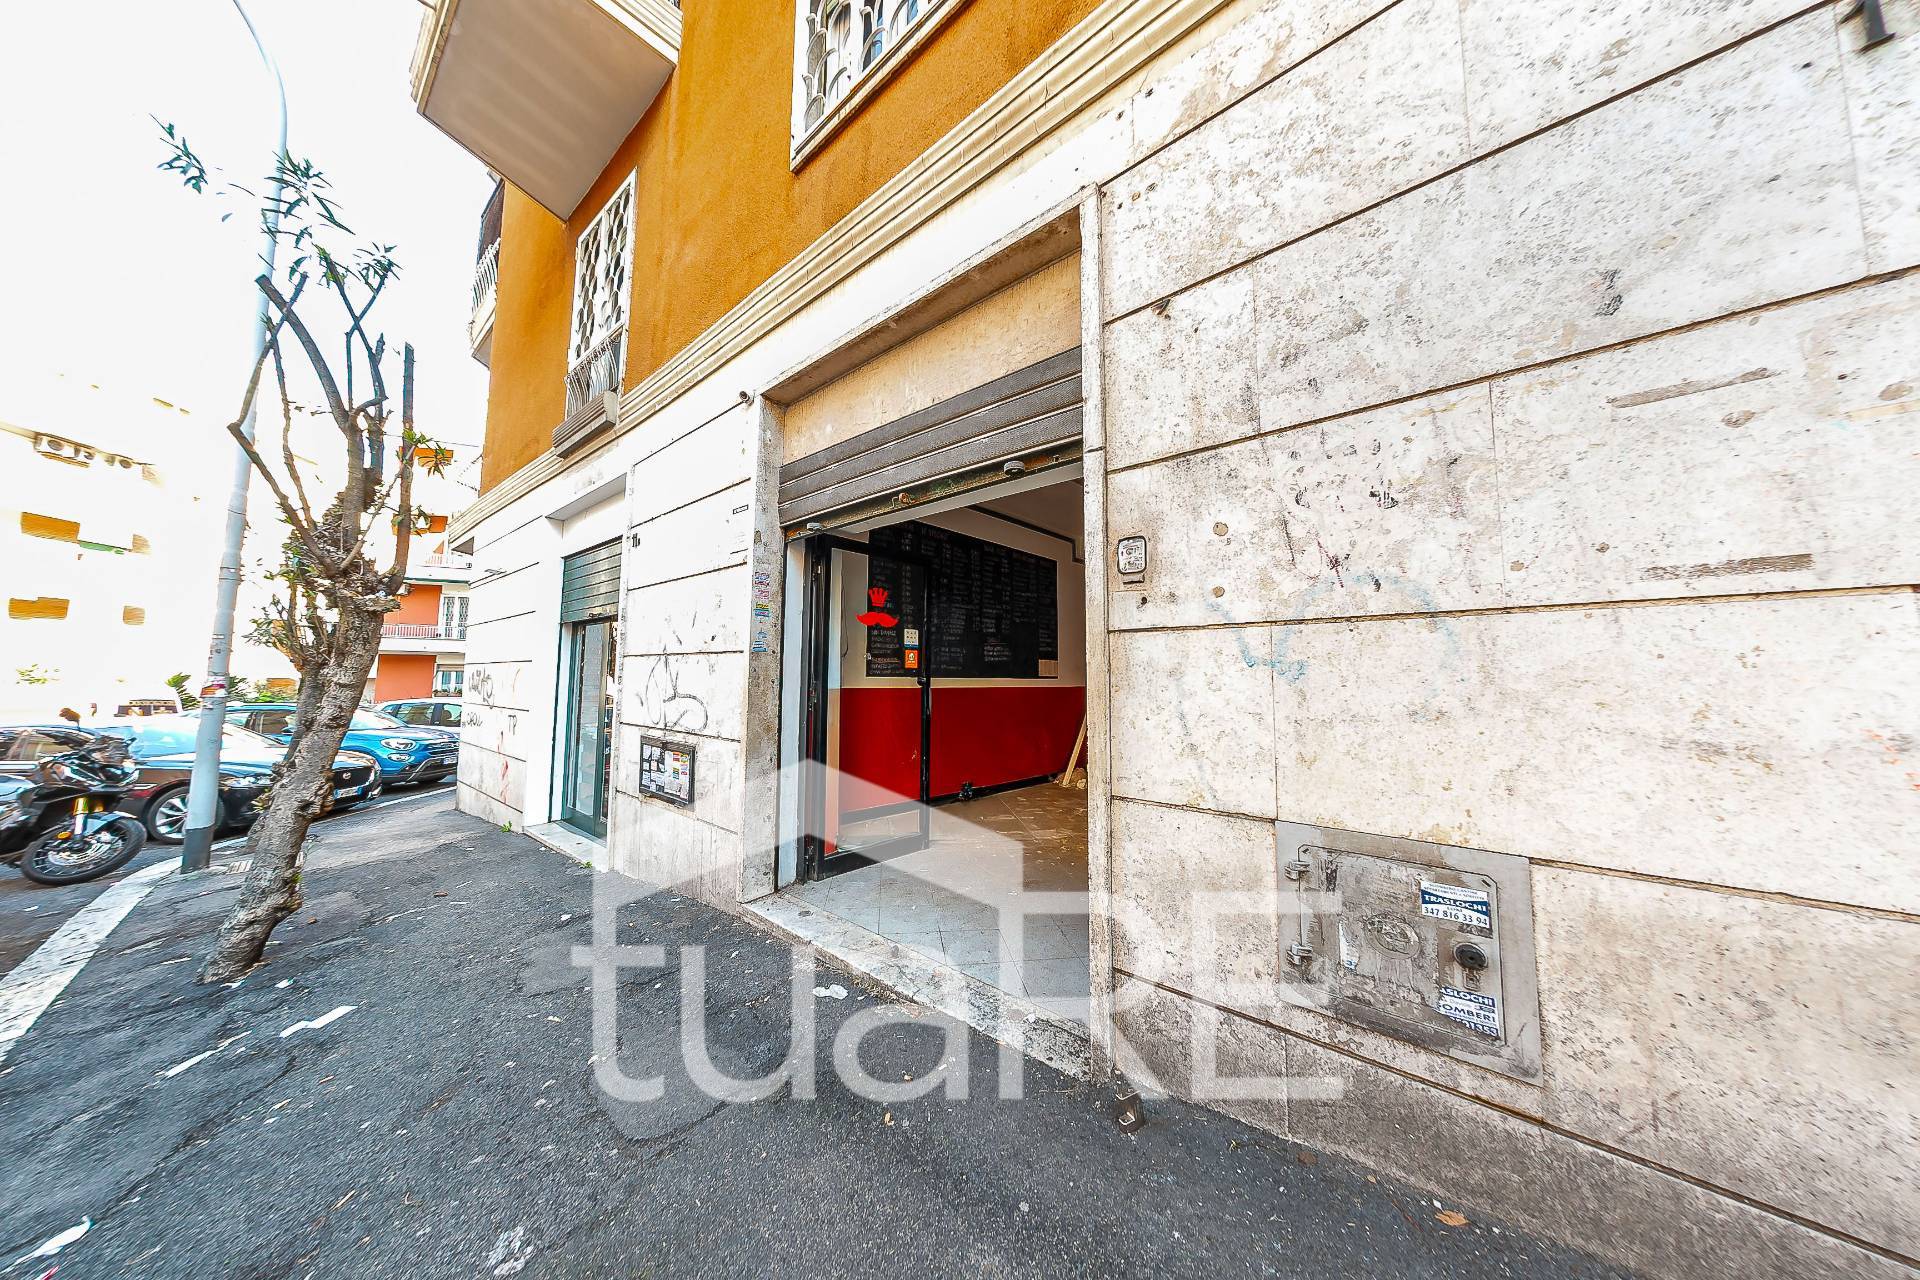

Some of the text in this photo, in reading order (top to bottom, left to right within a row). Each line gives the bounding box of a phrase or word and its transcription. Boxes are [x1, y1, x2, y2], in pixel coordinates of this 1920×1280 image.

[1424, 895, 1486, 911] TRASLOCHI
[1424, 906, 1439, 916] 347
[1442, 910, 1459, 920] 816
[1462, 913, 1473, 923] 33
[1438, 1003, 1496, 1023] OMBERI
